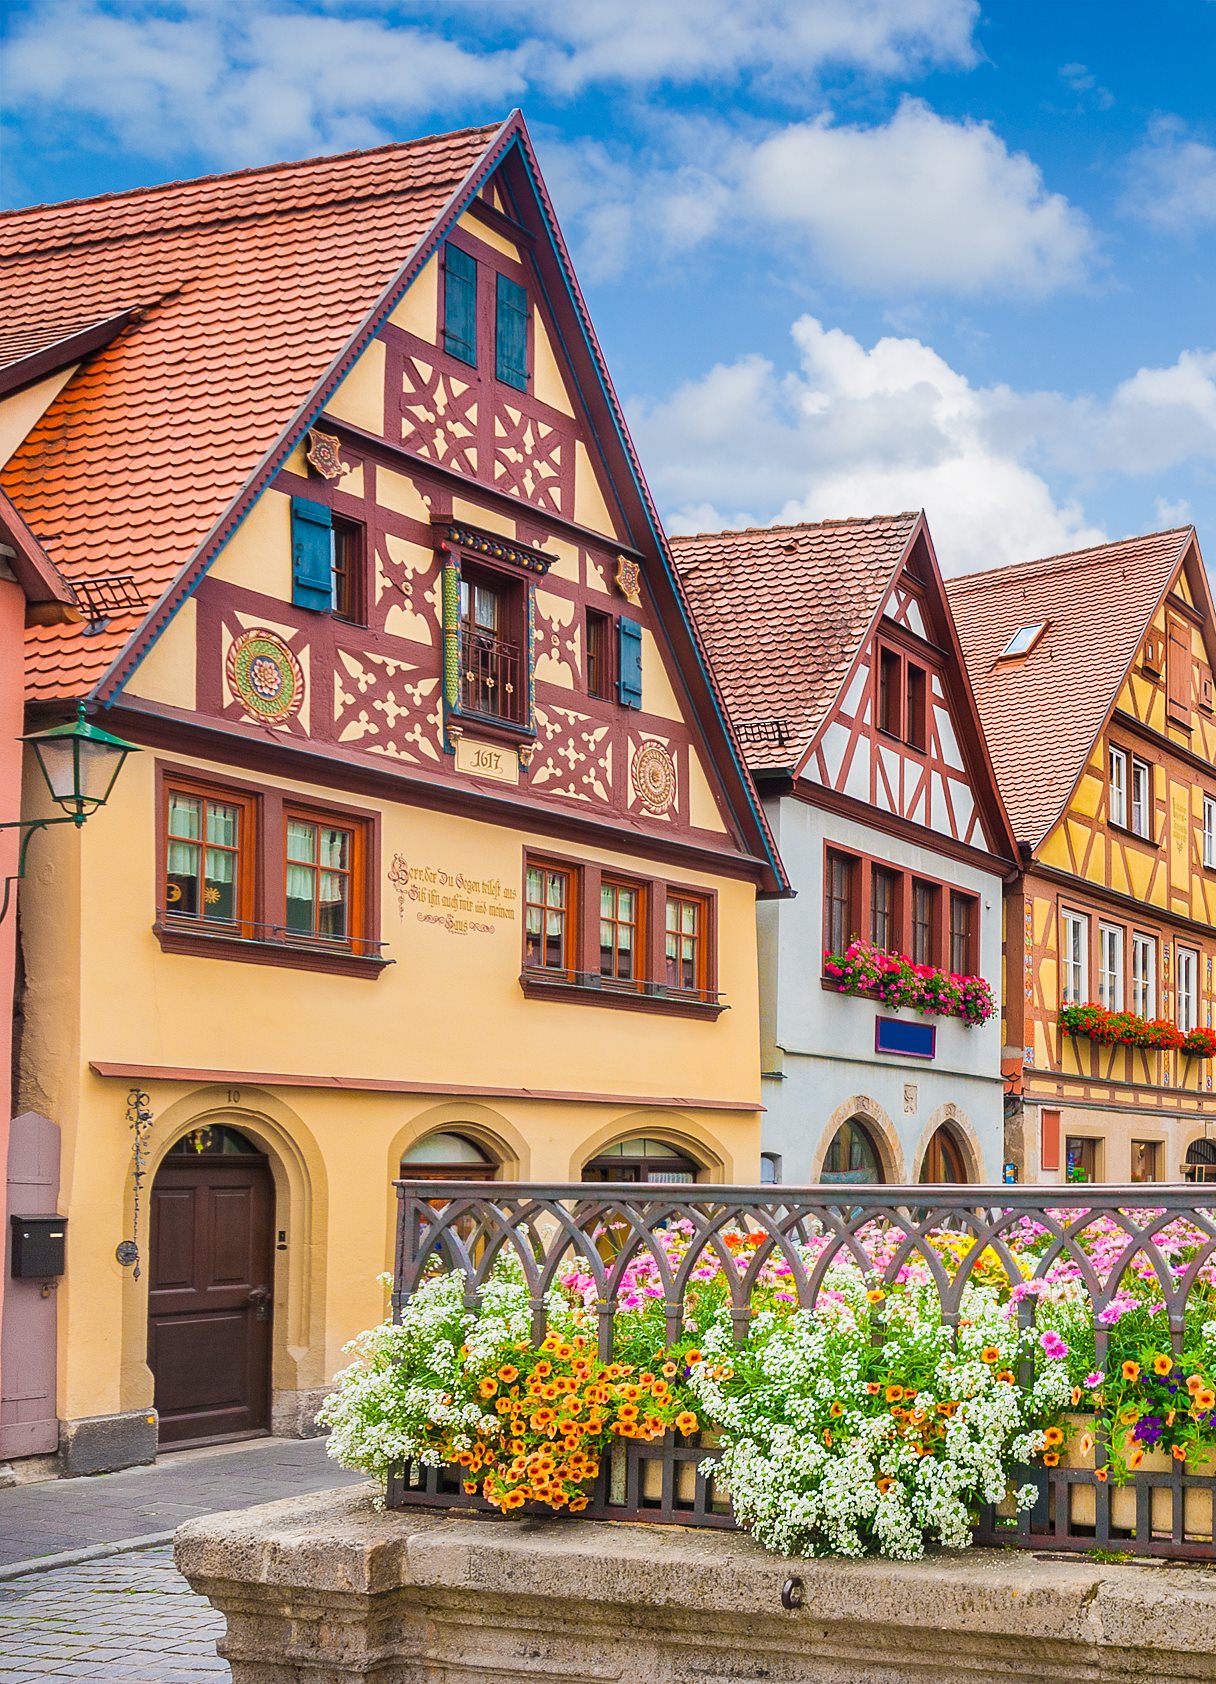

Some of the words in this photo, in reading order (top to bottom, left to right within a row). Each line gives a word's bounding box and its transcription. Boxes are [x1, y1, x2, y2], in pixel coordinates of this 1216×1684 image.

[470, 749, 503, 774] 1617
[503, 888, 517, 900] aus
[227, 1089, 241, 1103] 10
